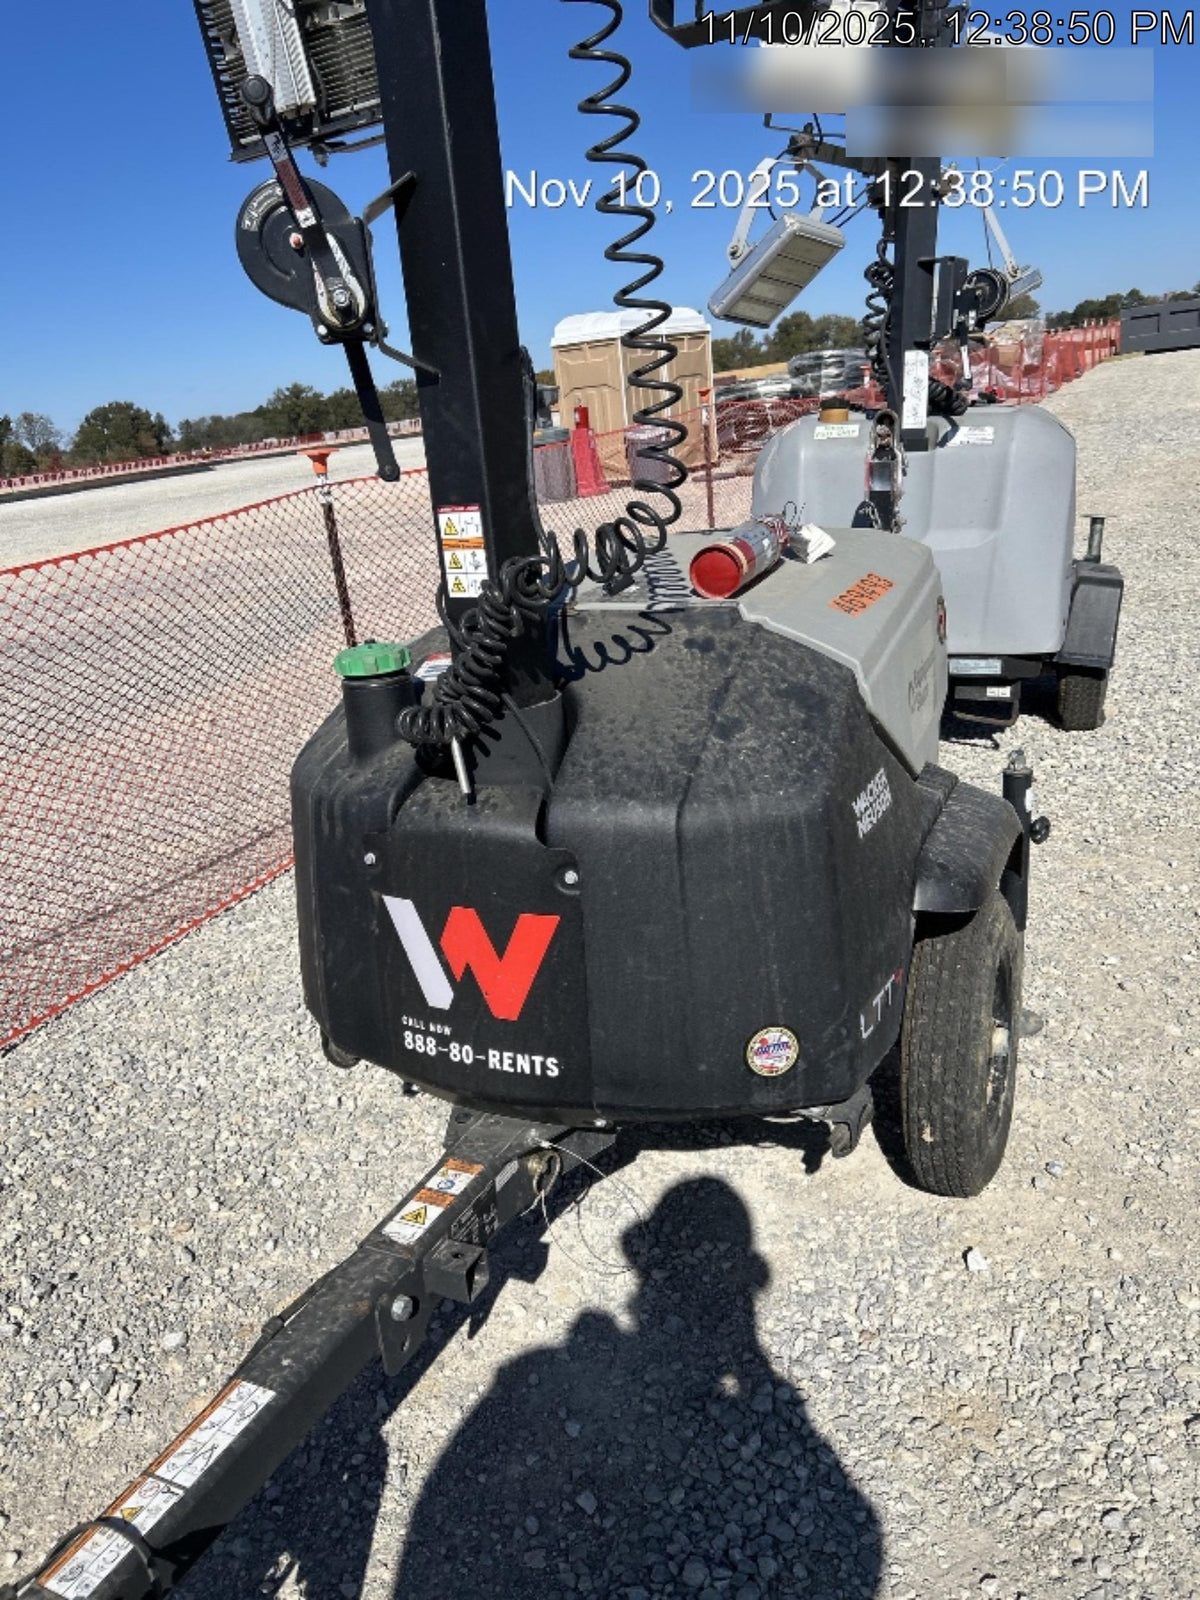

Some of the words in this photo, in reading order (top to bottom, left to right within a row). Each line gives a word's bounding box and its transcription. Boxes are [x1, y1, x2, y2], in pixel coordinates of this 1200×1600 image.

[852, 767, 887, 817] WACKER
[856, 787, 892, 839] NEUSON
[402, 1015, 426, 1030] CALL
[429, 1022, 452, 1036] NOW
[404, 1031, 559, 1077] 888-80-RENTS
